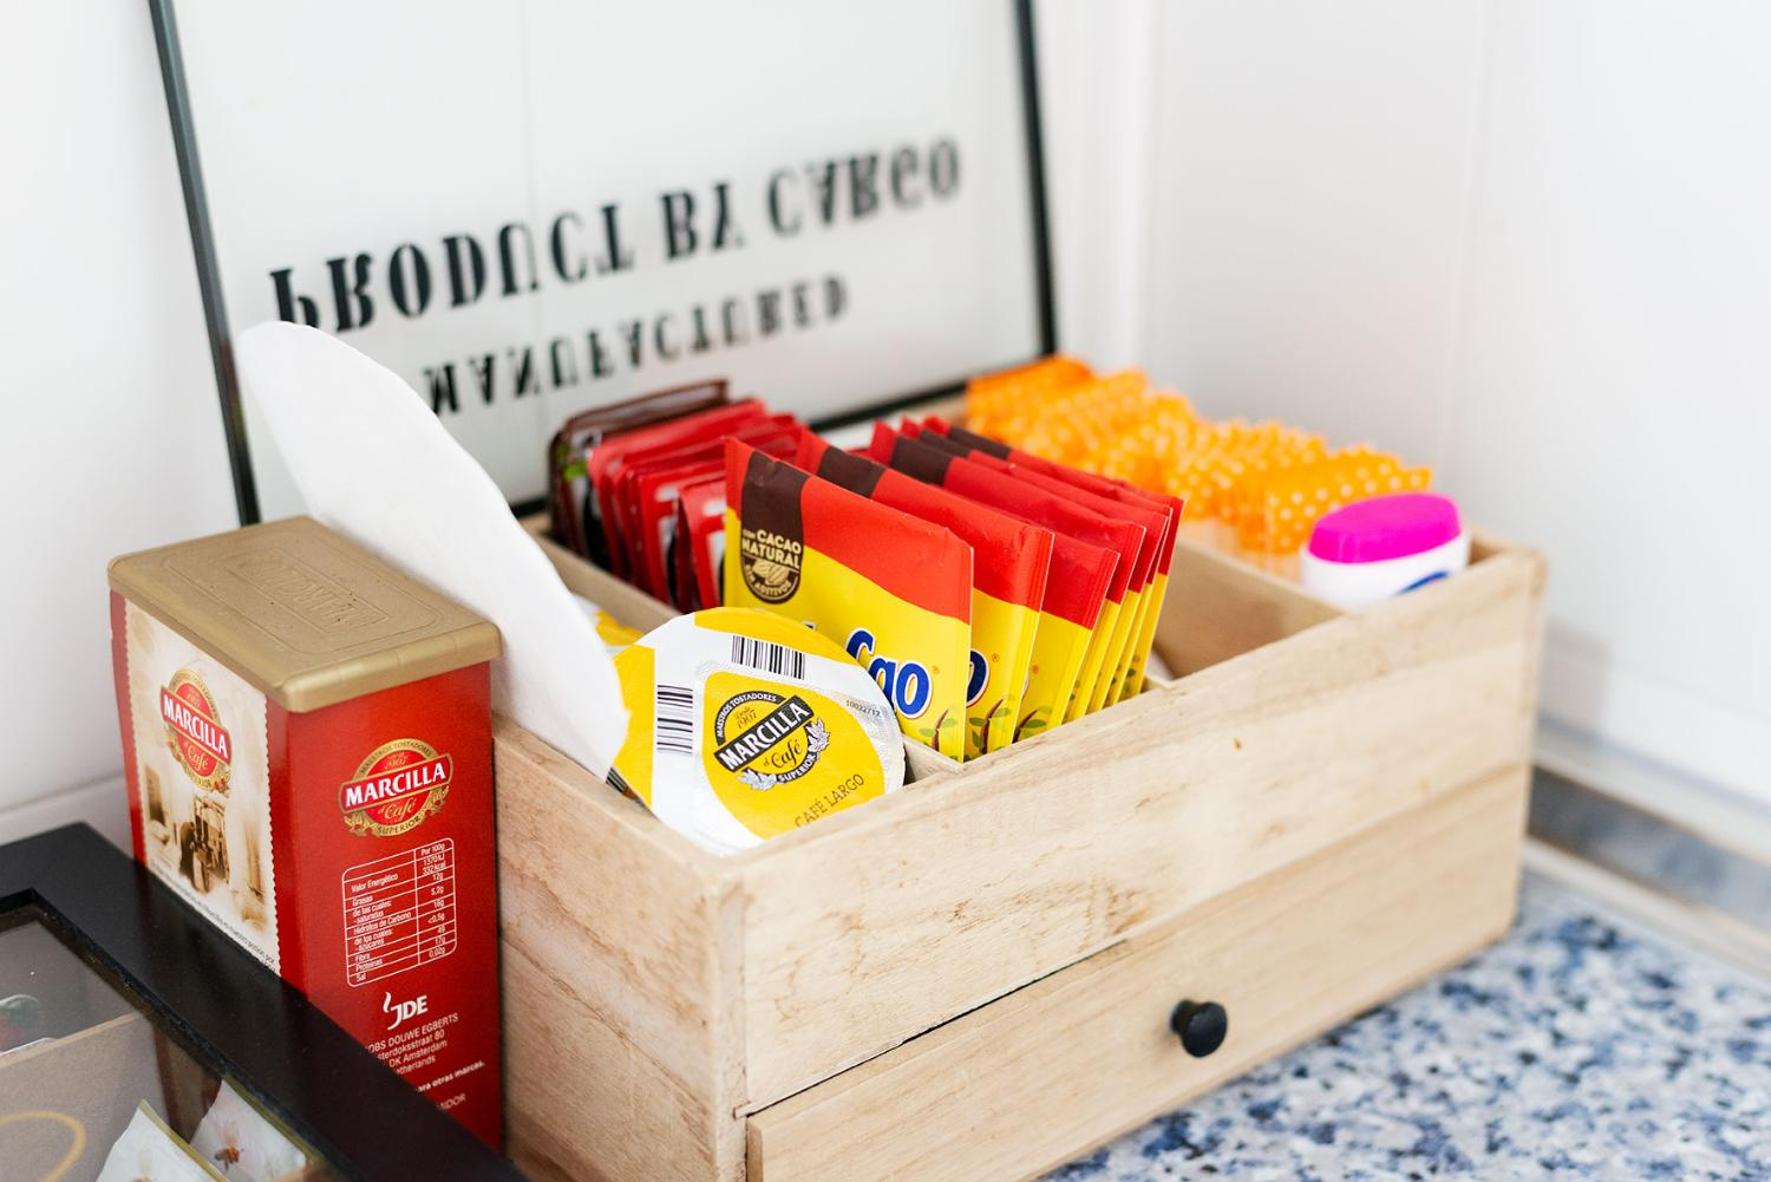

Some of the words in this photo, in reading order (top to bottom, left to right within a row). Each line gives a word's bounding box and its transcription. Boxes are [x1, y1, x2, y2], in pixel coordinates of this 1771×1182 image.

[742, 538, 800, 569] NATURAL
[756, 529, 802, 555] CACAO
[730, 691, 777, 707] TOSTADORES
[163, 694, 229, 759] MARCILLA
[718, 702, 810, 771] MARCILLA
[187, 745, 209, 771] Café
[771, 738, 803, 769] Café
[777, 753, 817, 783] SUPERIOR
[345, 762, 447, 808] MARCILLA
[384, 797, 417, 822] Café
[795, 799, 828, 828] CAFÉ
[824, 773, 865, 807] LARGO
[376, 814, 421, 835] SUPERIOR
[420, 846, 432, 856] Por
[432, 843, 445, 853] 100g
[351, 881, 367, 893] Valor
[367, 873, 399, 888] Energético
[352, 908, 362, 918] de
[353, 922, 379, 935] Hidratos
[379, 918, 387, 928] de
[387, 911, 412, 925] Carbono
[354, 936, 363, 946] de
[355, 952, 371, 962] Fibra
[356, 972, 367, 982] Sal
[387, 995, 429, 1031] JDE
[367, 1039, 386, 1054] OBS
[388, 1028, 421, 1047] DOUWE
[421, 1012, 459, 1034] EGBERTS
[377, 1033, 433, 1060] sterdoksstraat
[434, 1028, 445, 1041] 80
[403, 1039, 448, 1064] Amsterdam
[431, 1073, 454, 1088] otras
